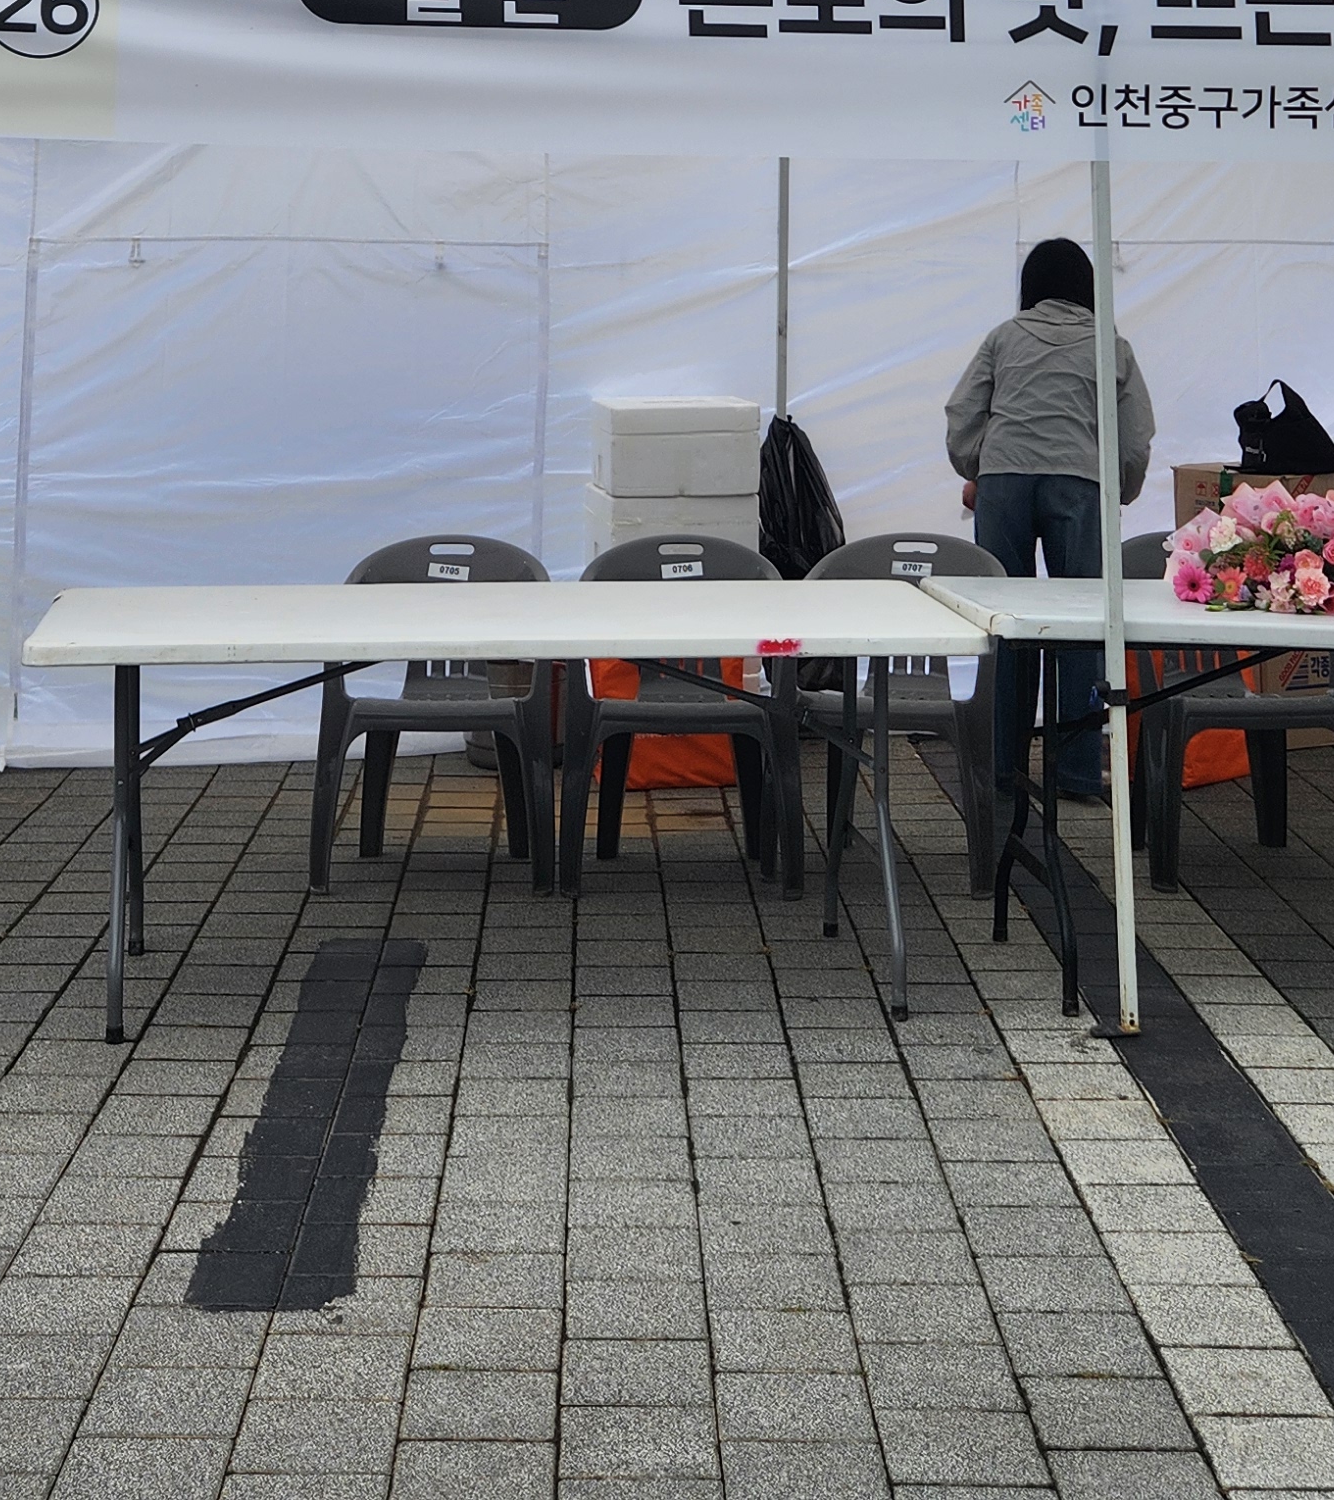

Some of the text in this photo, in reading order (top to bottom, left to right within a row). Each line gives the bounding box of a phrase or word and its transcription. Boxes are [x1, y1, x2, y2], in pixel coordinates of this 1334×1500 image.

[1010, 110, 1046, 132] 센터
[439, 565, 460, 575] 0705
[672, 564, 693, 573] 0706
[902, 563, 923, 572] 0707
